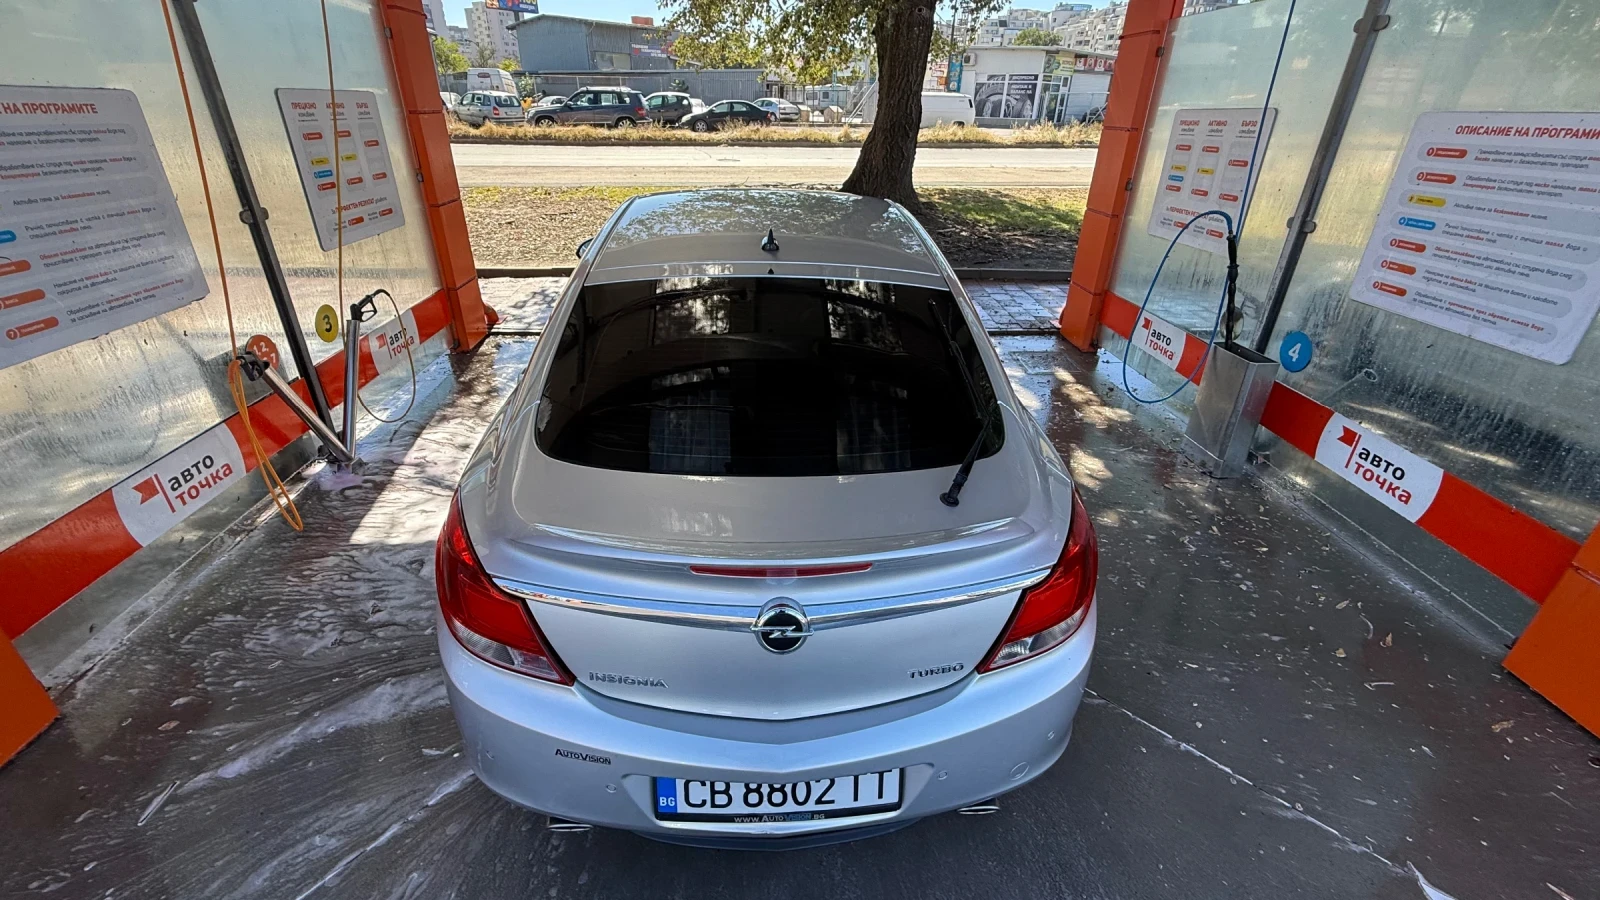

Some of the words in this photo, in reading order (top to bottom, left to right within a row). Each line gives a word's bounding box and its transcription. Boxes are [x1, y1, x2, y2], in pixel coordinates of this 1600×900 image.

[2, 103, 21, 114] НА
[21, 103, 98, 114] ПРОГРАМИТЕ
[1455, 124, 1514, 136] ОПИСАНИЕ
[1513, 127, 1530, 137] НА
[322, 314, 332, 332] 3
[1151, 328, 1172, 347] авто
[1149, 340, 1174, 361] точка
[1288, 343, 1302, 362] 4
[1358, 447, 1405, 480] авто
[168, 455, 214, 492] авто
[175, 463, 233, 506] точка
[1354, 462, 1412, 505] точка
[908, 662, 964, 679] TURBO
[589, 672, 669, 689] INSIGNIA
[660, 796, 675, 807] BG
[684, 780, 732, 808] CB
[743, 778, 835, 808] 8802
